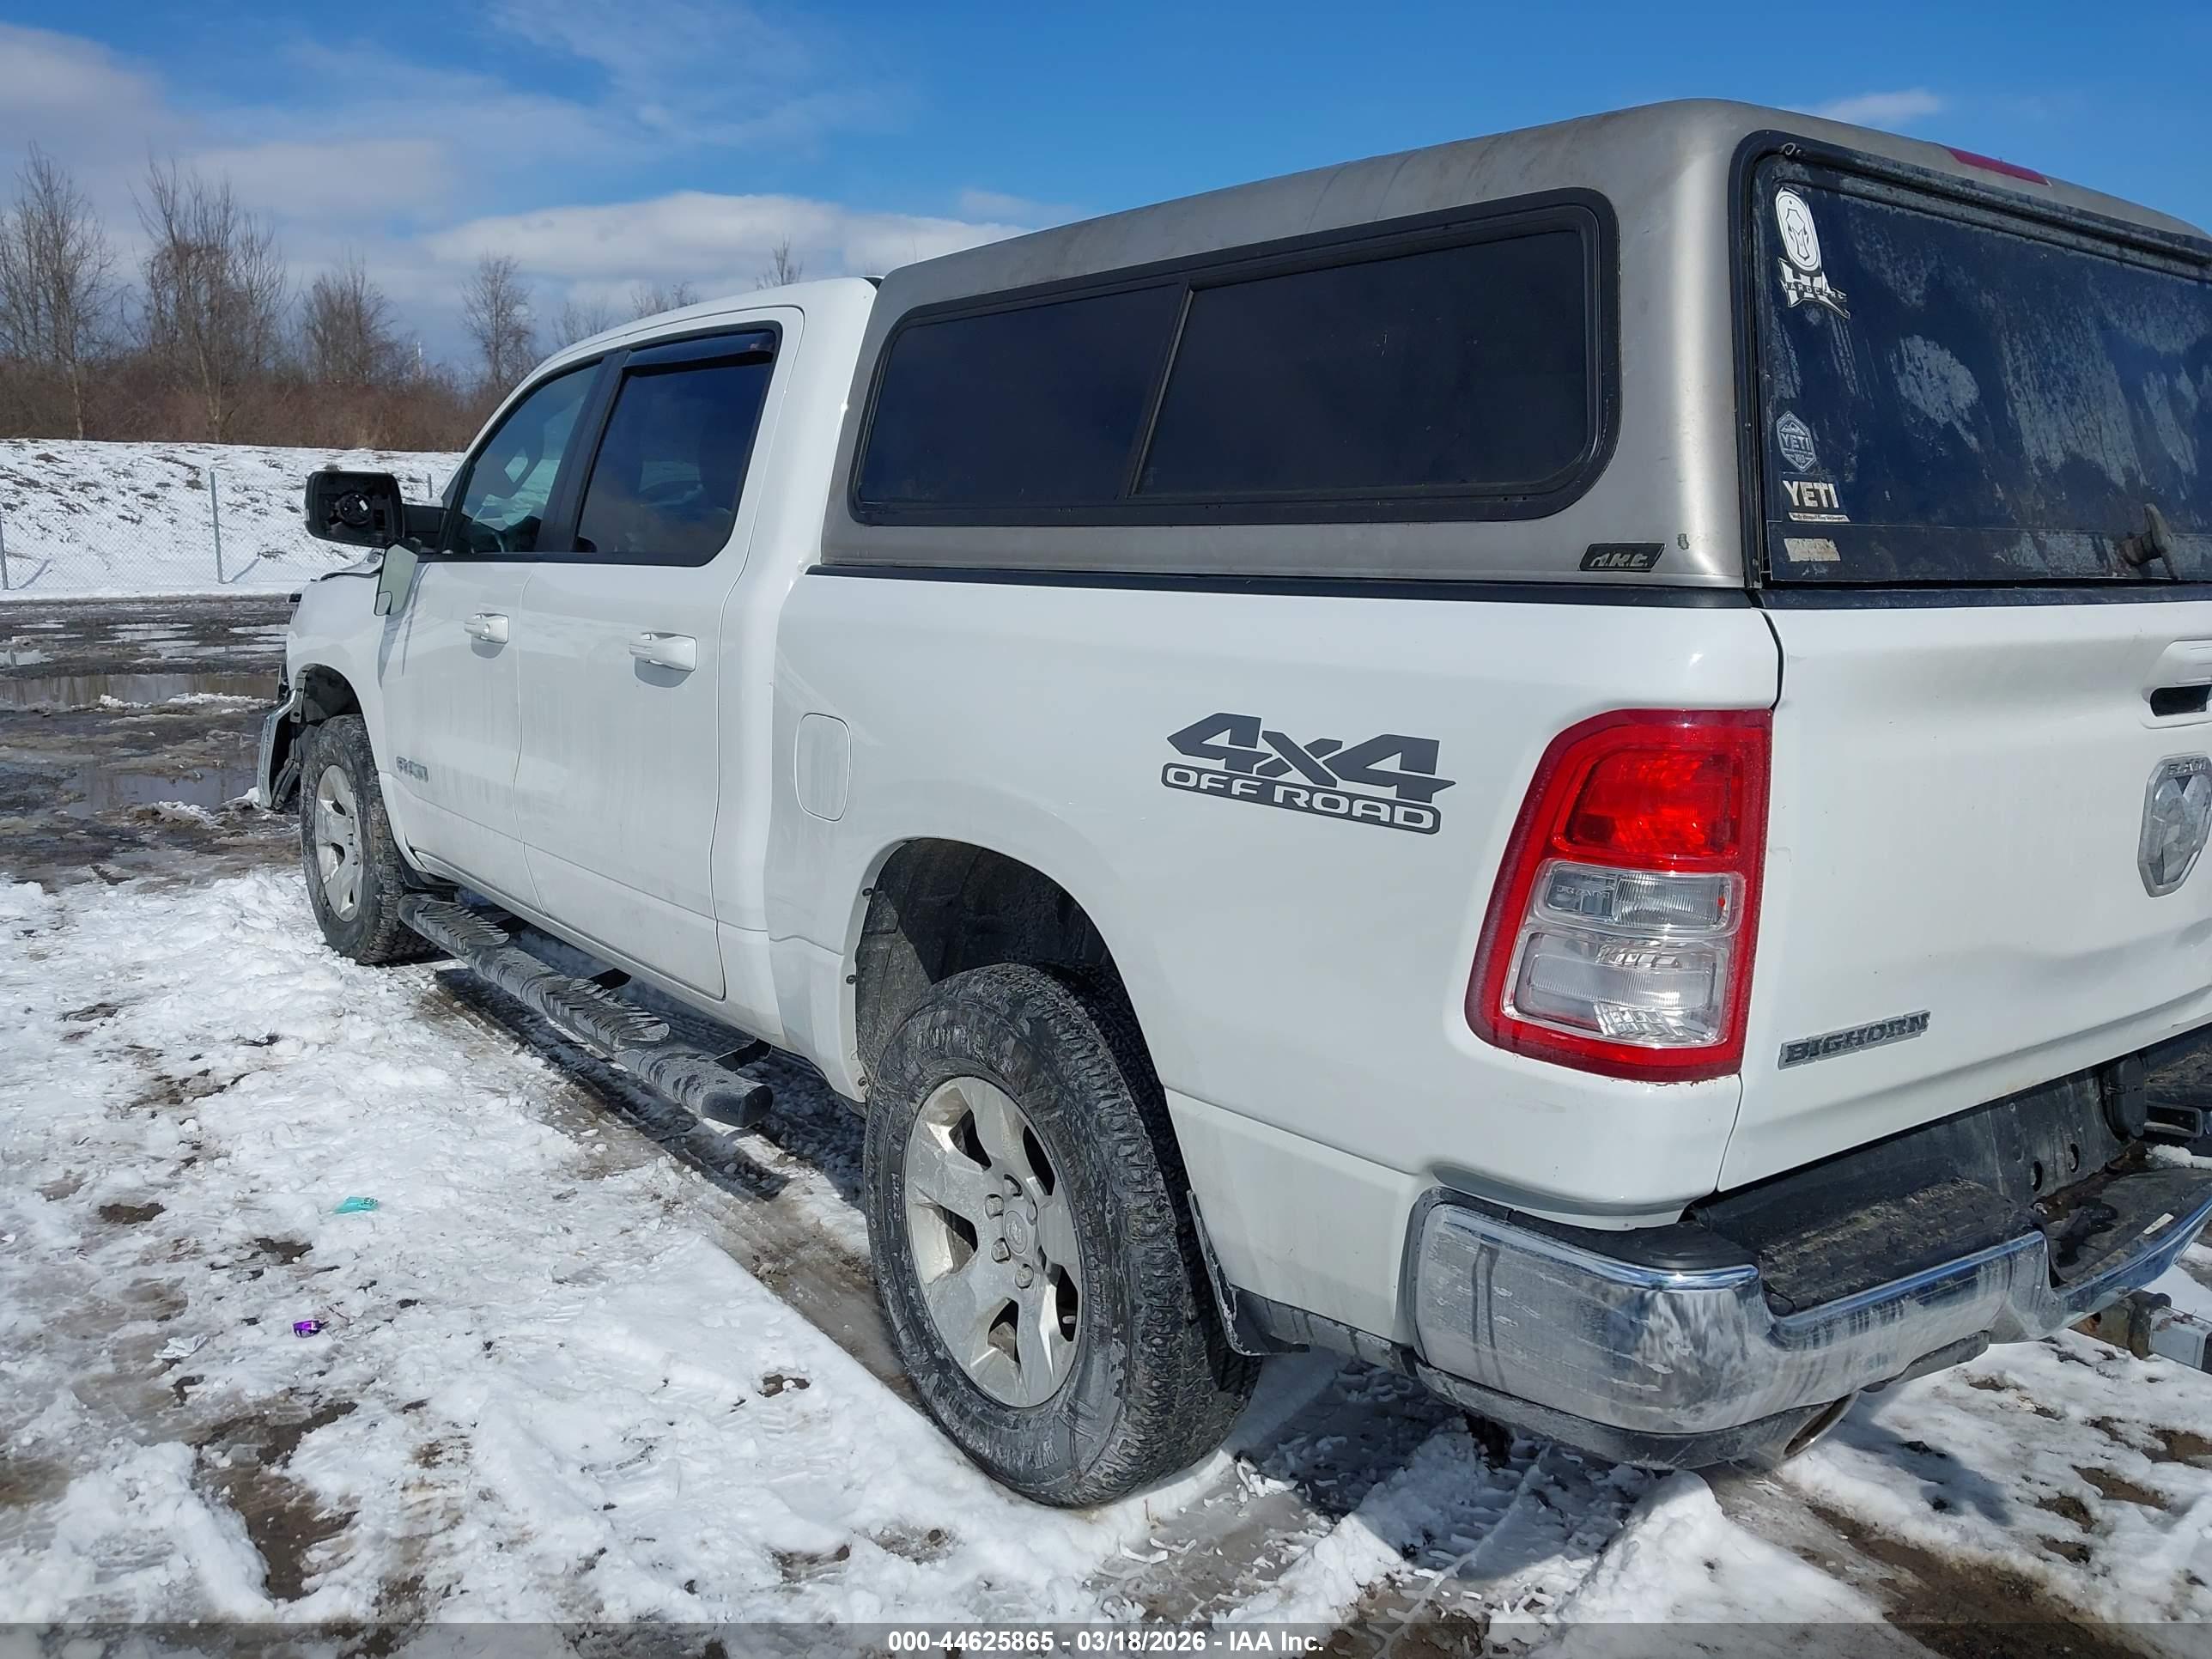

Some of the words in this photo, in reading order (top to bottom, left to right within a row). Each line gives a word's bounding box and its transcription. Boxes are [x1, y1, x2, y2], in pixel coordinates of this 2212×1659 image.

[1780, 432, 1812, 453] YETI
[1782, 479, 1840, 508] YETI
[1165, 766, 1263, 796] OFF
[1273, 784, 1436, 830] ROAD
[1780, 1010, 1931, 1068] BIGHORN
